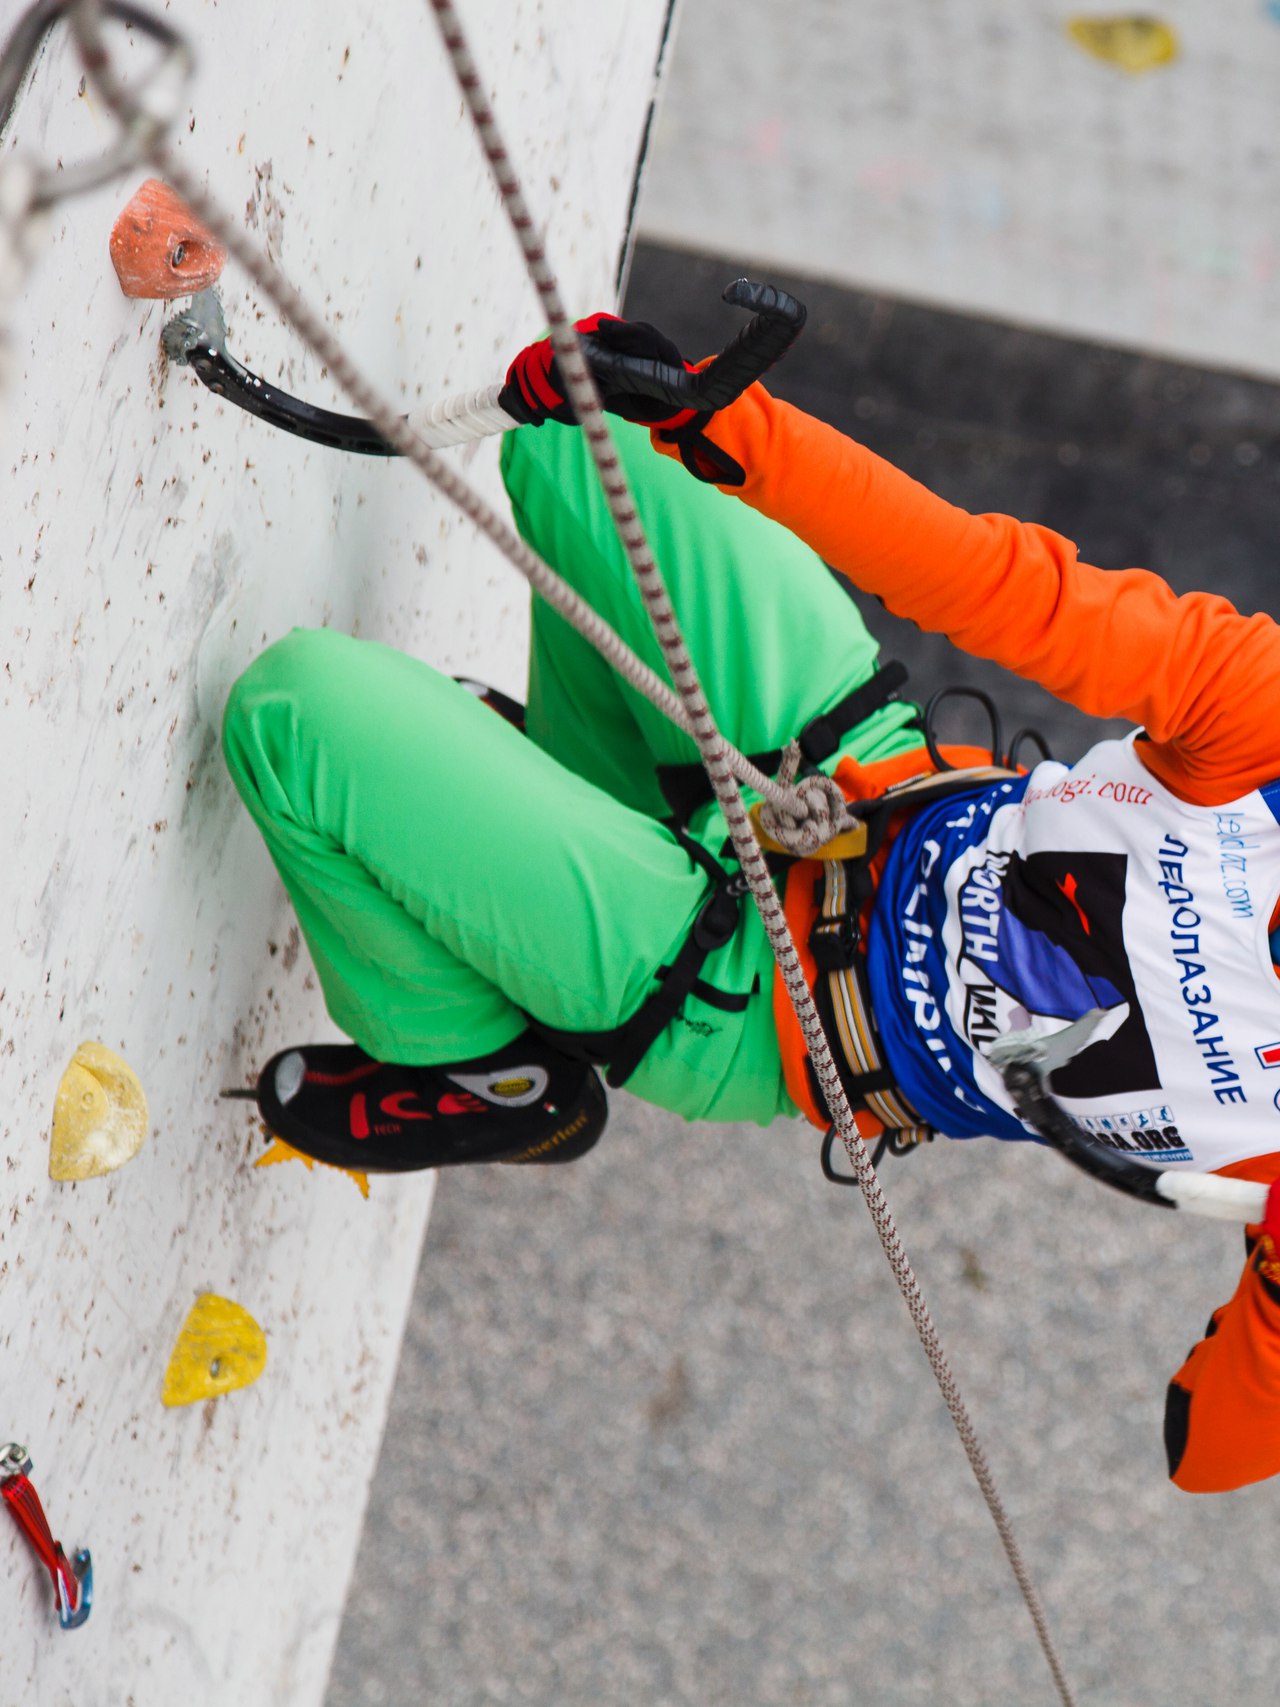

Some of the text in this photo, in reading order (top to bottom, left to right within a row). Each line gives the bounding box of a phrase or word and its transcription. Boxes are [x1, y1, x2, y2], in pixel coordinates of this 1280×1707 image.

[960, 851, 1010, 962] NORTH
[1158, 832, 1248, 1105] ЛЕДОЛАЗАНИЕ
[349, 1091, 489, 1140] ICE
